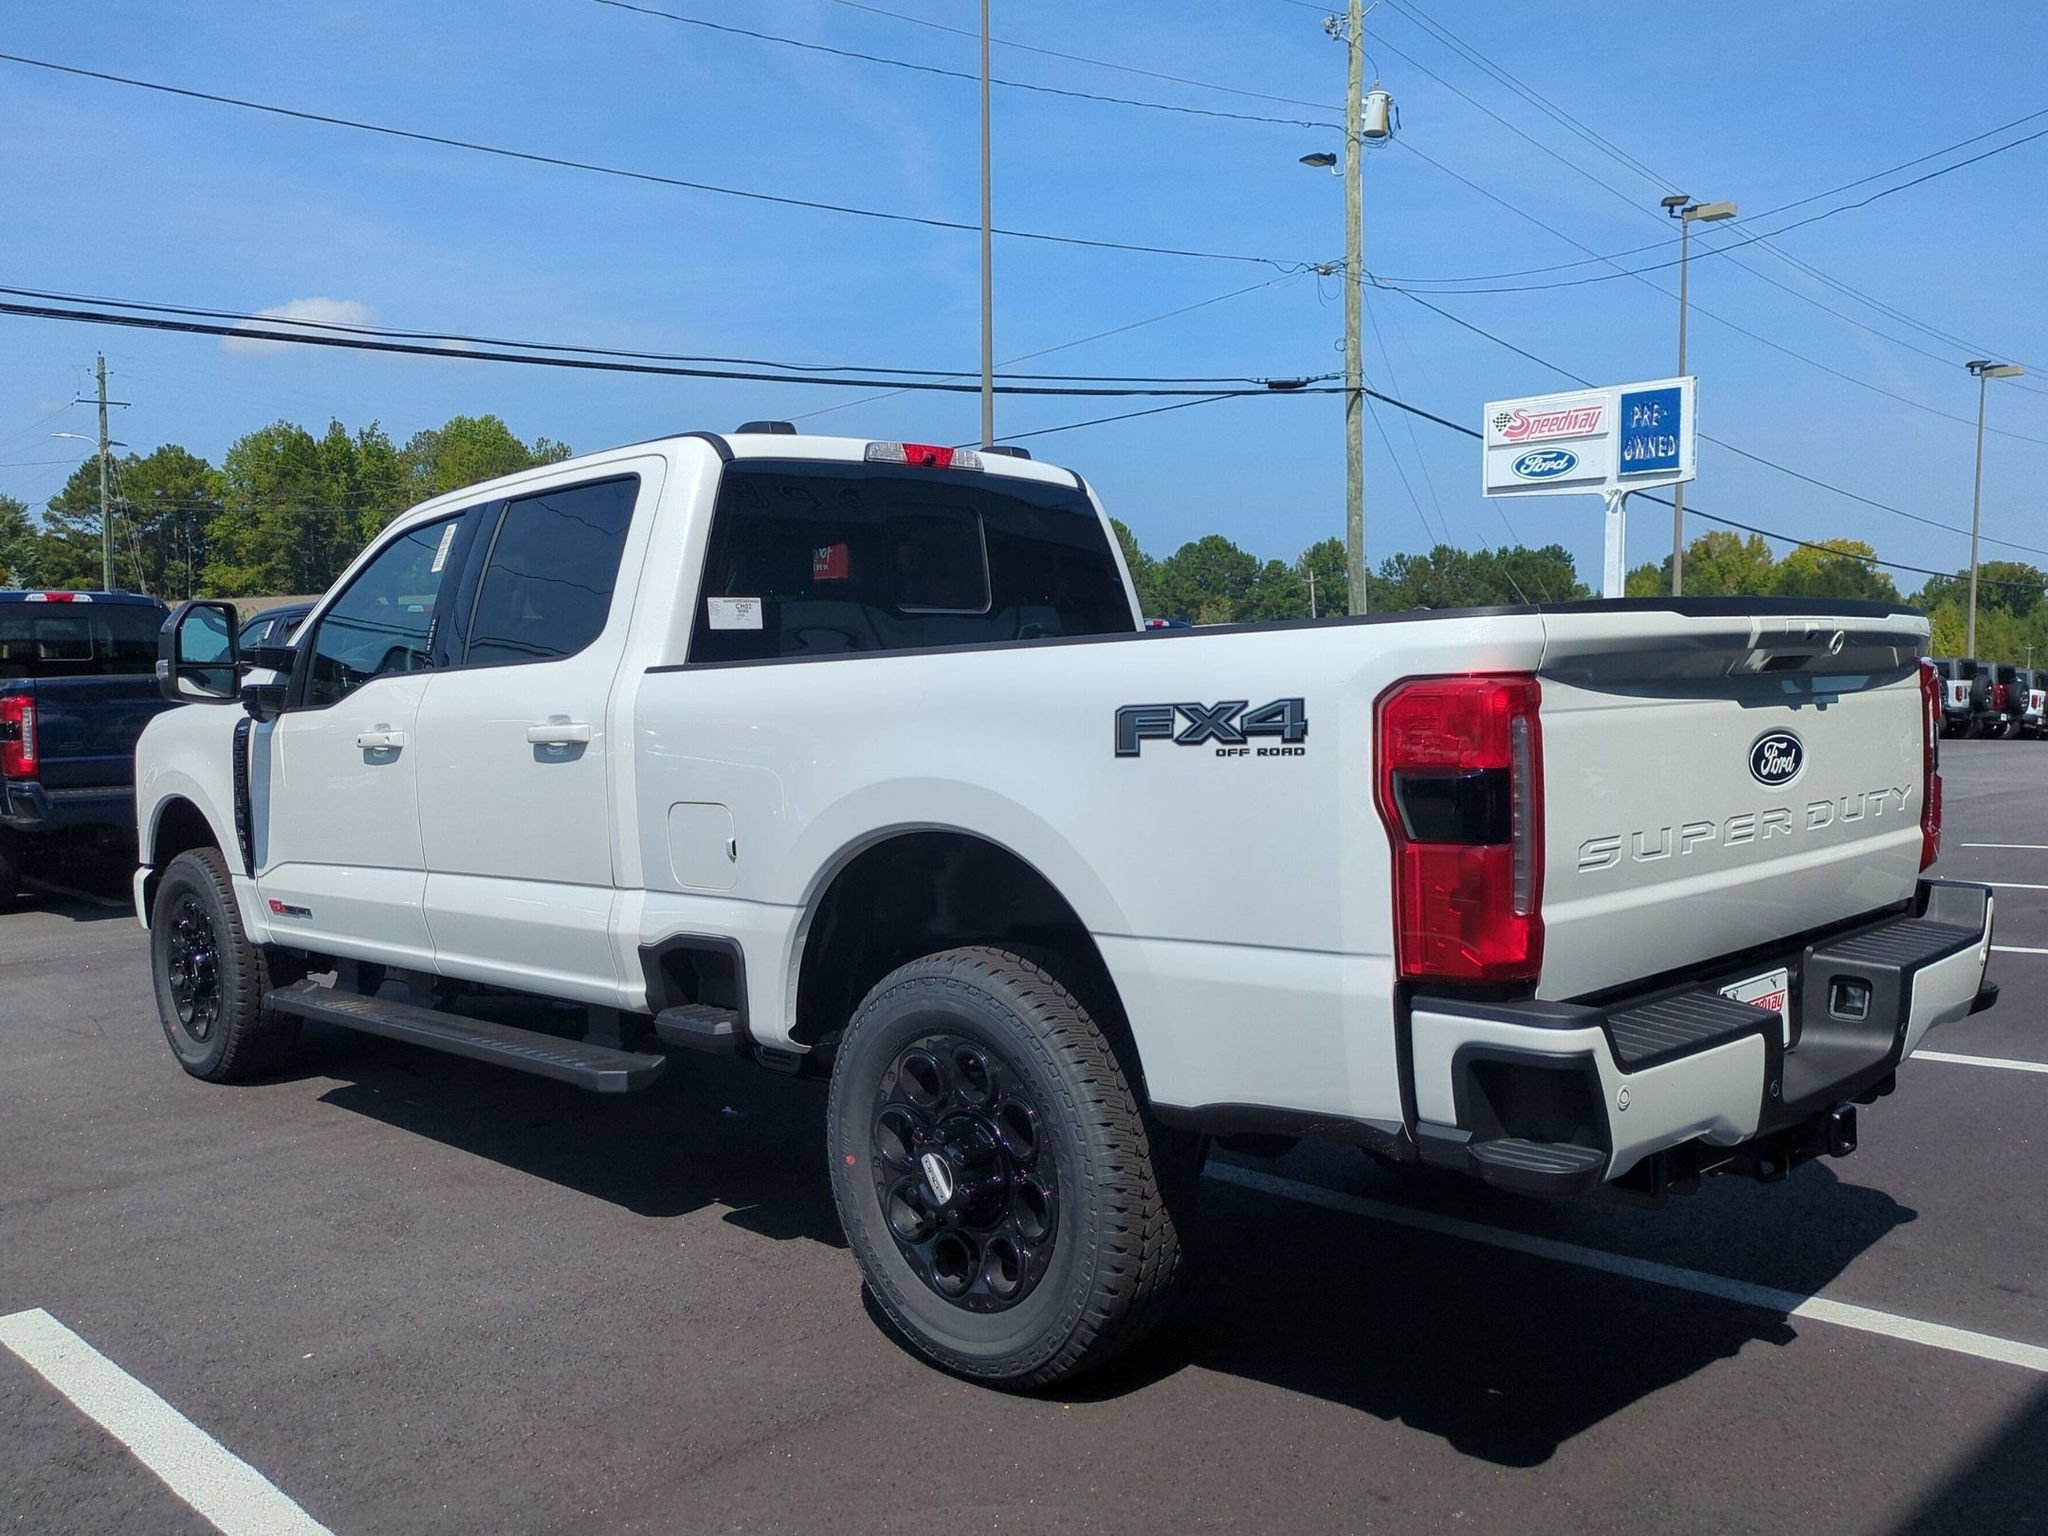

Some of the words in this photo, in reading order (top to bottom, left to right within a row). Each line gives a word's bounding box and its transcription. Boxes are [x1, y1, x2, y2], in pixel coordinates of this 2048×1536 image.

[1503, 408, 1602, 440] Speedway
[1519, 452, 1570, 475] Ford
[1624, 434, 1677, 461] OWNED
[1115, 698, 1308, 758] FX4
[1216, 748, 1250, 757] OFF
[1256, 747, 1305, 757] ROAD
[1760, 742, 1796, 776] Ford
[1577, 807, 1793, 873] SUPER
[1805, 784, 1912, 831] DUTY
